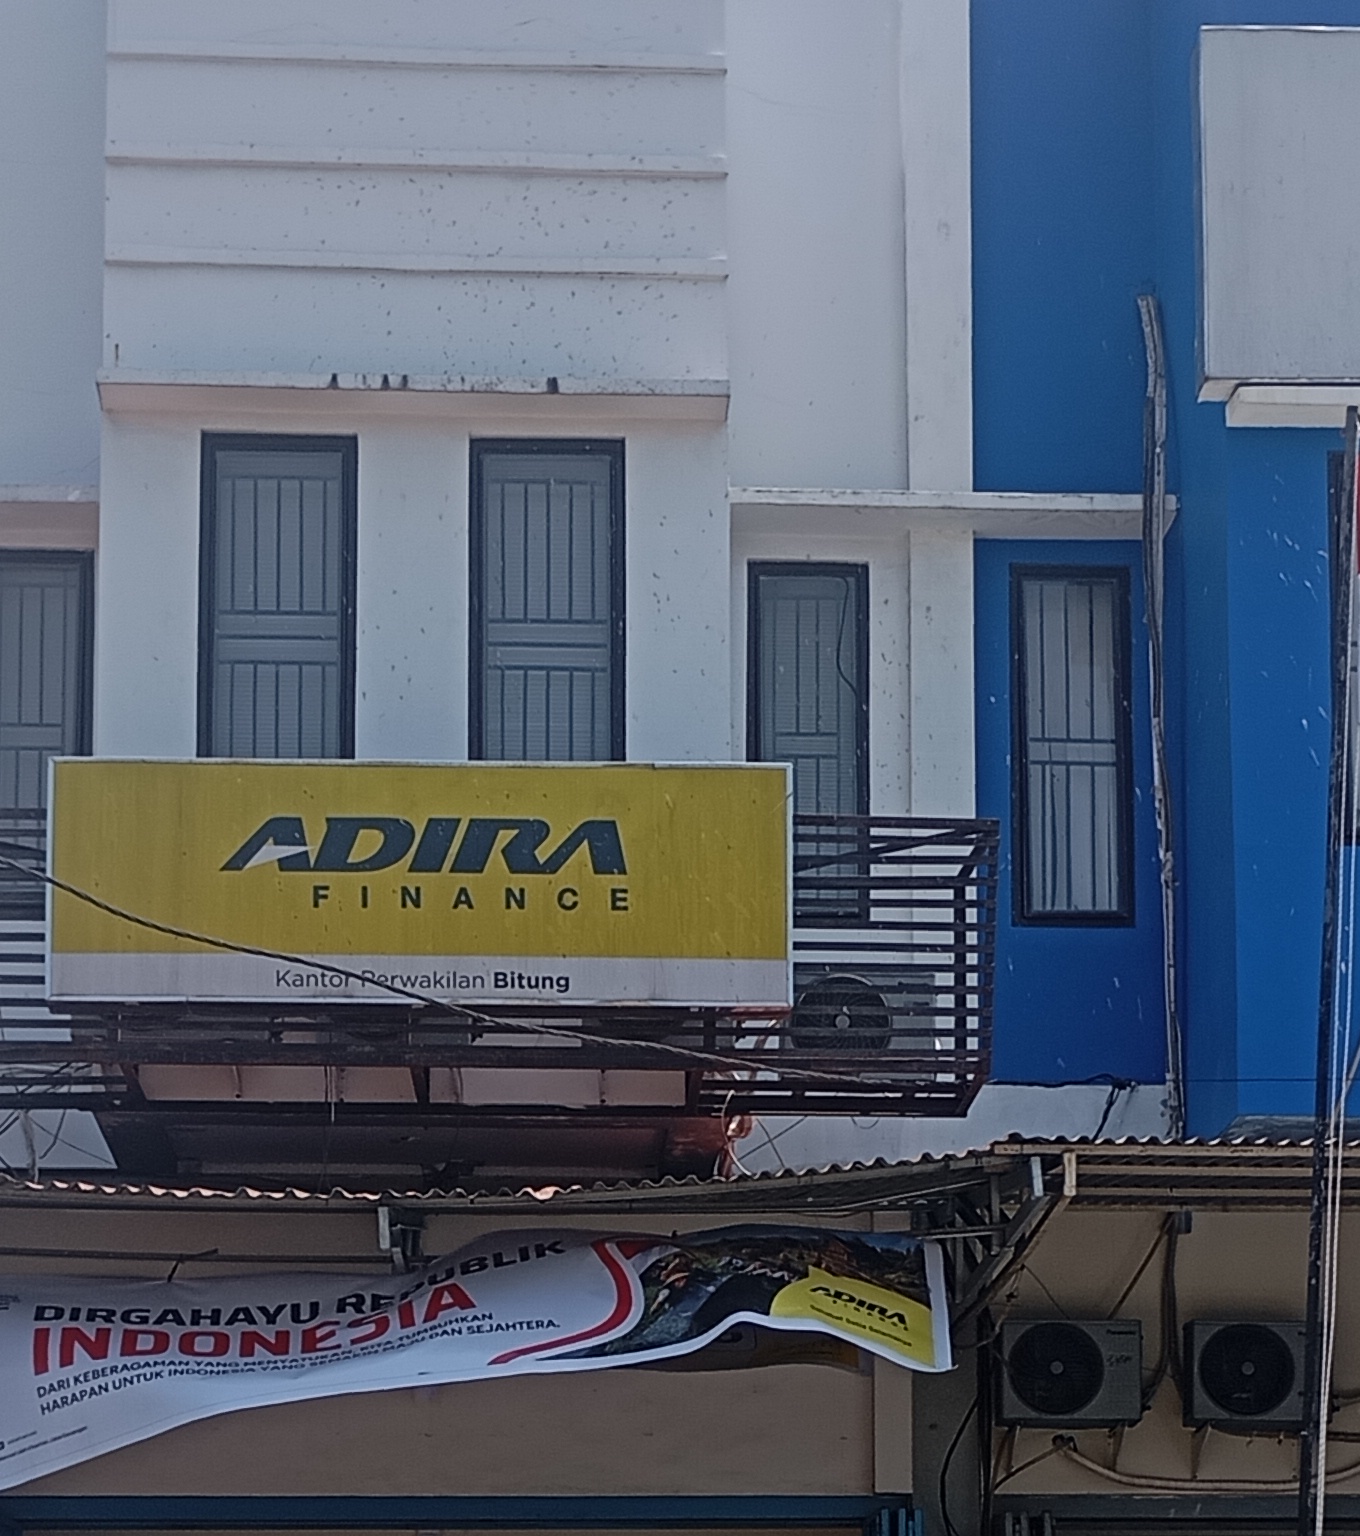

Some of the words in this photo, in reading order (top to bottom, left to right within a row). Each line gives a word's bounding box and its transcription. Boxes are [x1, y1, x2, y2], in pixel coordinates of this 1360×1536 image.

[218, 816, 628, 875] ADIRA
[312, 885, 629, 911] FINANCE
[275, 969, 351, 989] Kantor
[361, 970, 486, 990] Perwakilan
[493, 971, 570, 993] Bitung
[33, 1301, 320, 1326] DIRGAHAYU
[336, 1240, 567, 1314] REPUBLIK
[809, 1285, 908, 1326] ADIRA
[33, 1281, 477, 1376] INDONESIA
[36, 1377, 71, 1400] DARI
[72, 1360, 190, 1387] KEBERAGAMAN
[395, 1312, 493, 1342] TUMBUHKAN
[40, 1381, 110, 1416] HARAPAN
[112, 1368, 165, 1392] UNTUK
[167, 1366, 257, 1378] INDONESIA
[429, 1326, 463, 1340] DAN
